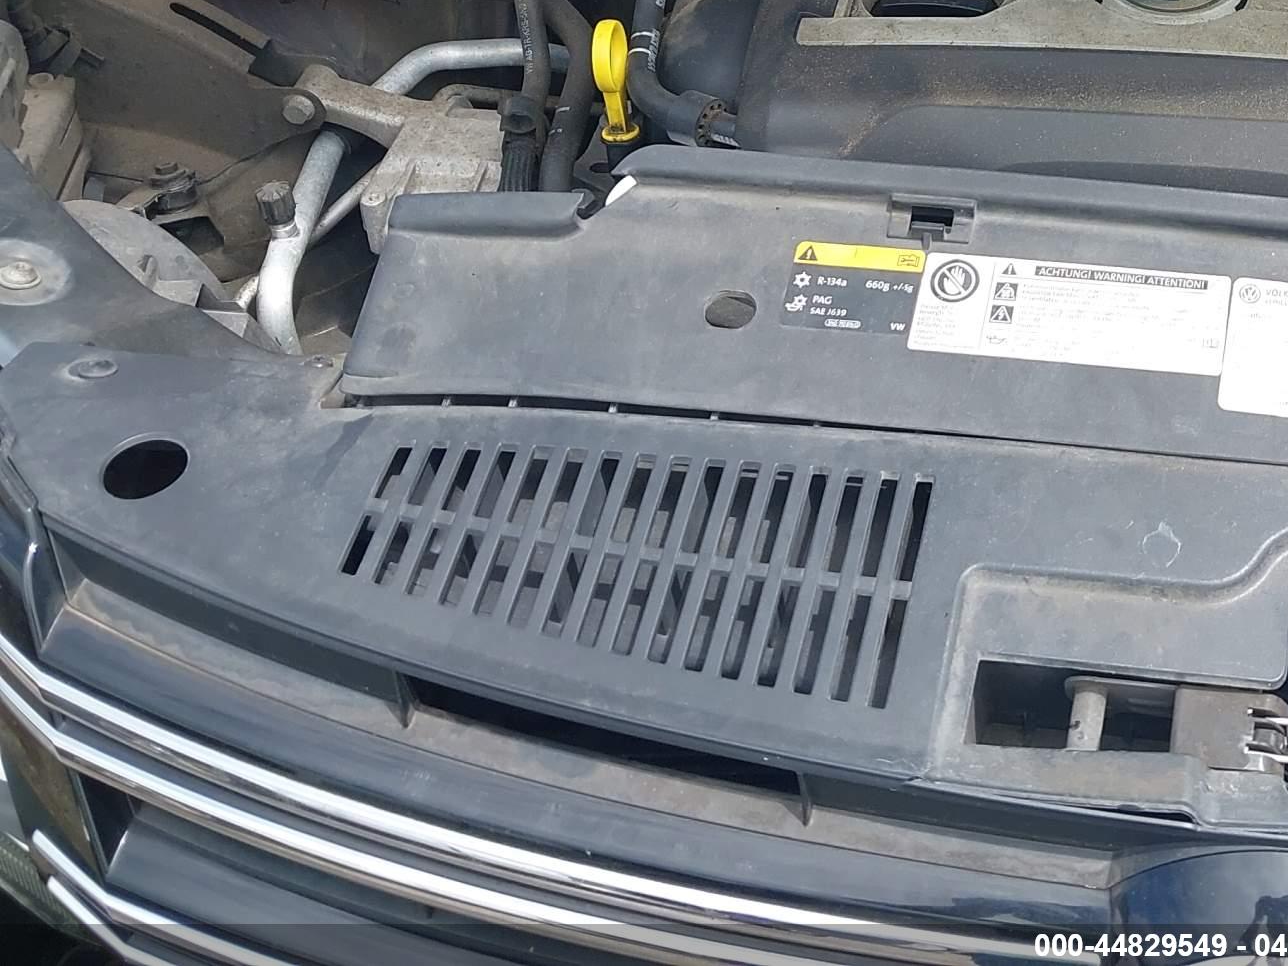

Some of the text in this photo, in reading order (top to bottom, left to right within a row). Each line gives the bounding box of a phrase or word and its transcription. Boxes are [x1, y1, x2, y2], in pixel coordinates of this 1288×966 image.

[1038, 266, 1207, 290] ACHTUNG! WARNING! ATTENTION!
[816, 275, 848, 288] R-134a
[865, 280, 890, 293] 660g
[812, 294, 833, 305] PAG
[810, 306, 848, 317] SAE J639
[890, 322, 906, 332] VW
